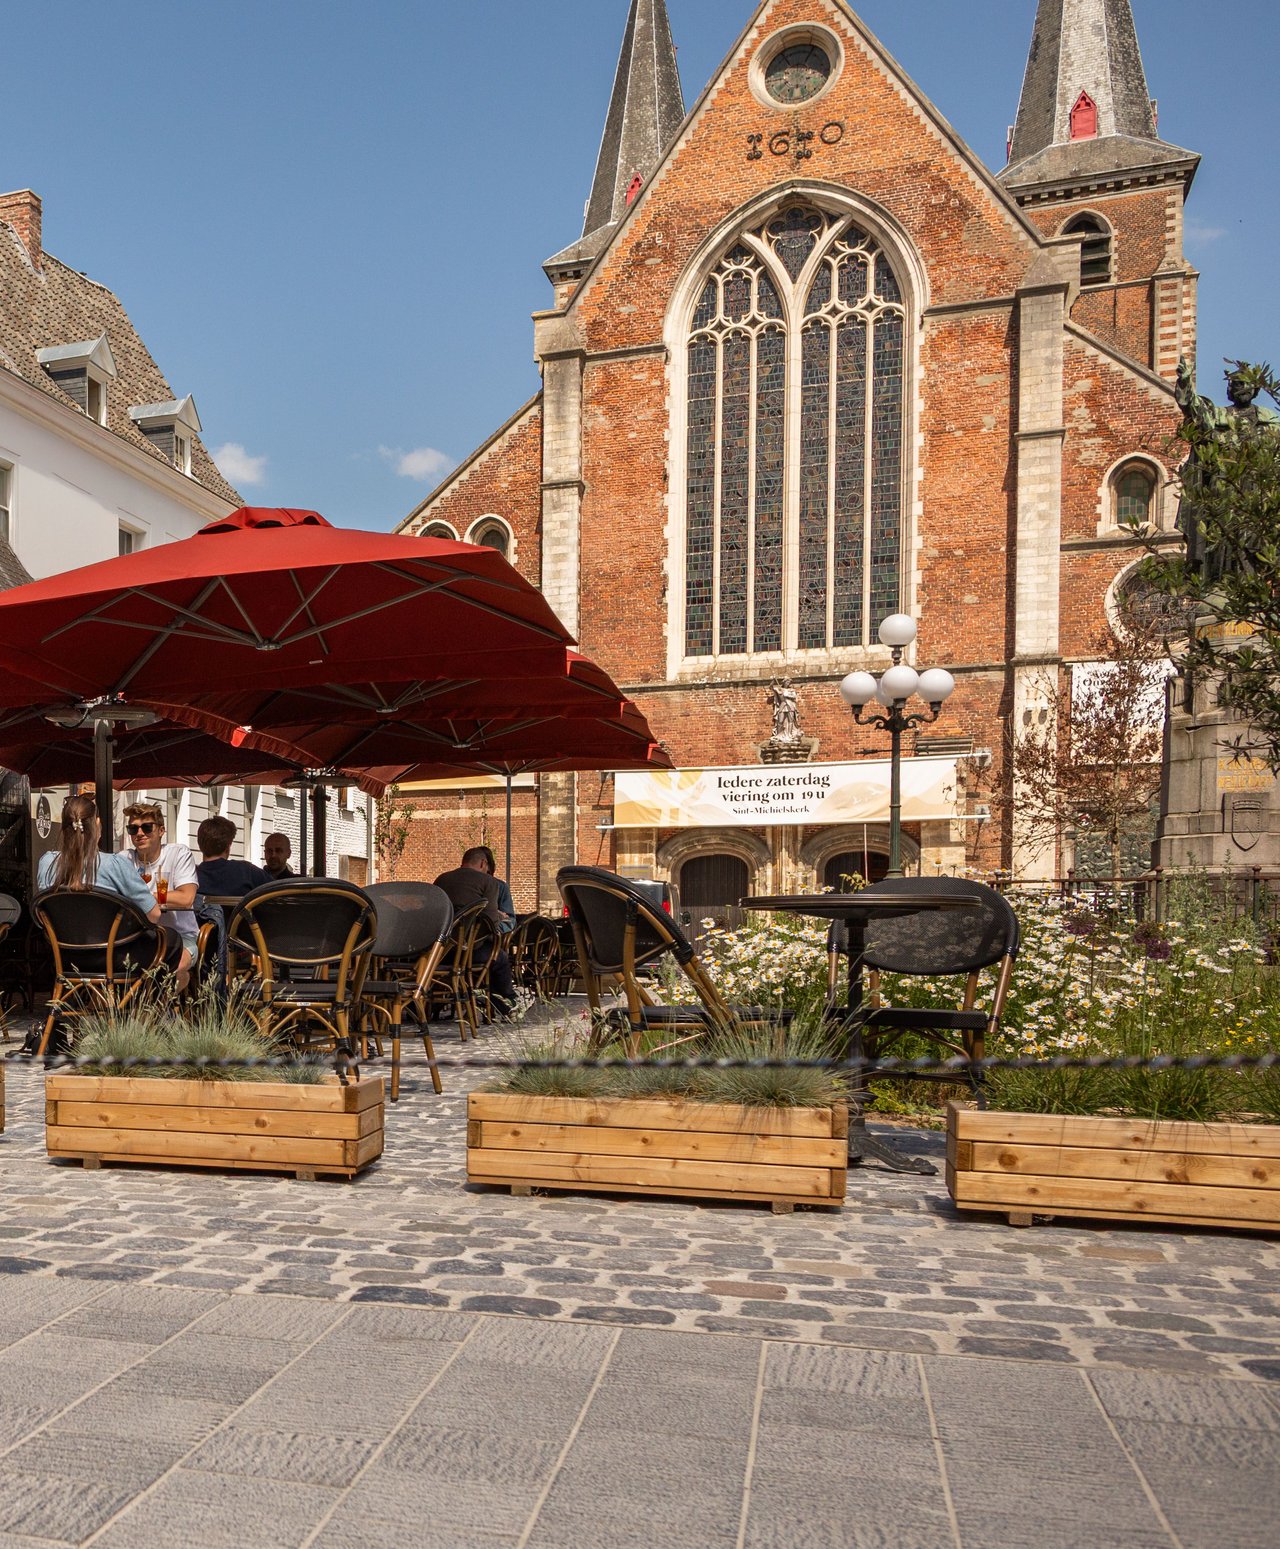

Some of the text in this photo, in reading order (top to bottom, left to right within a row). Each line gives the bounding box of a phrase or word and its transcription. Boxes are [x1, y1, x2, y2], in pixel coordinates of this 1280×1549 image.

[717, 773, 831, 788] Iedere zaterdag
[722, 790, 770, 804] viering
[772, 791, 795, 801] om
[732, 806, 810, 815] Sint-Michielskerk
